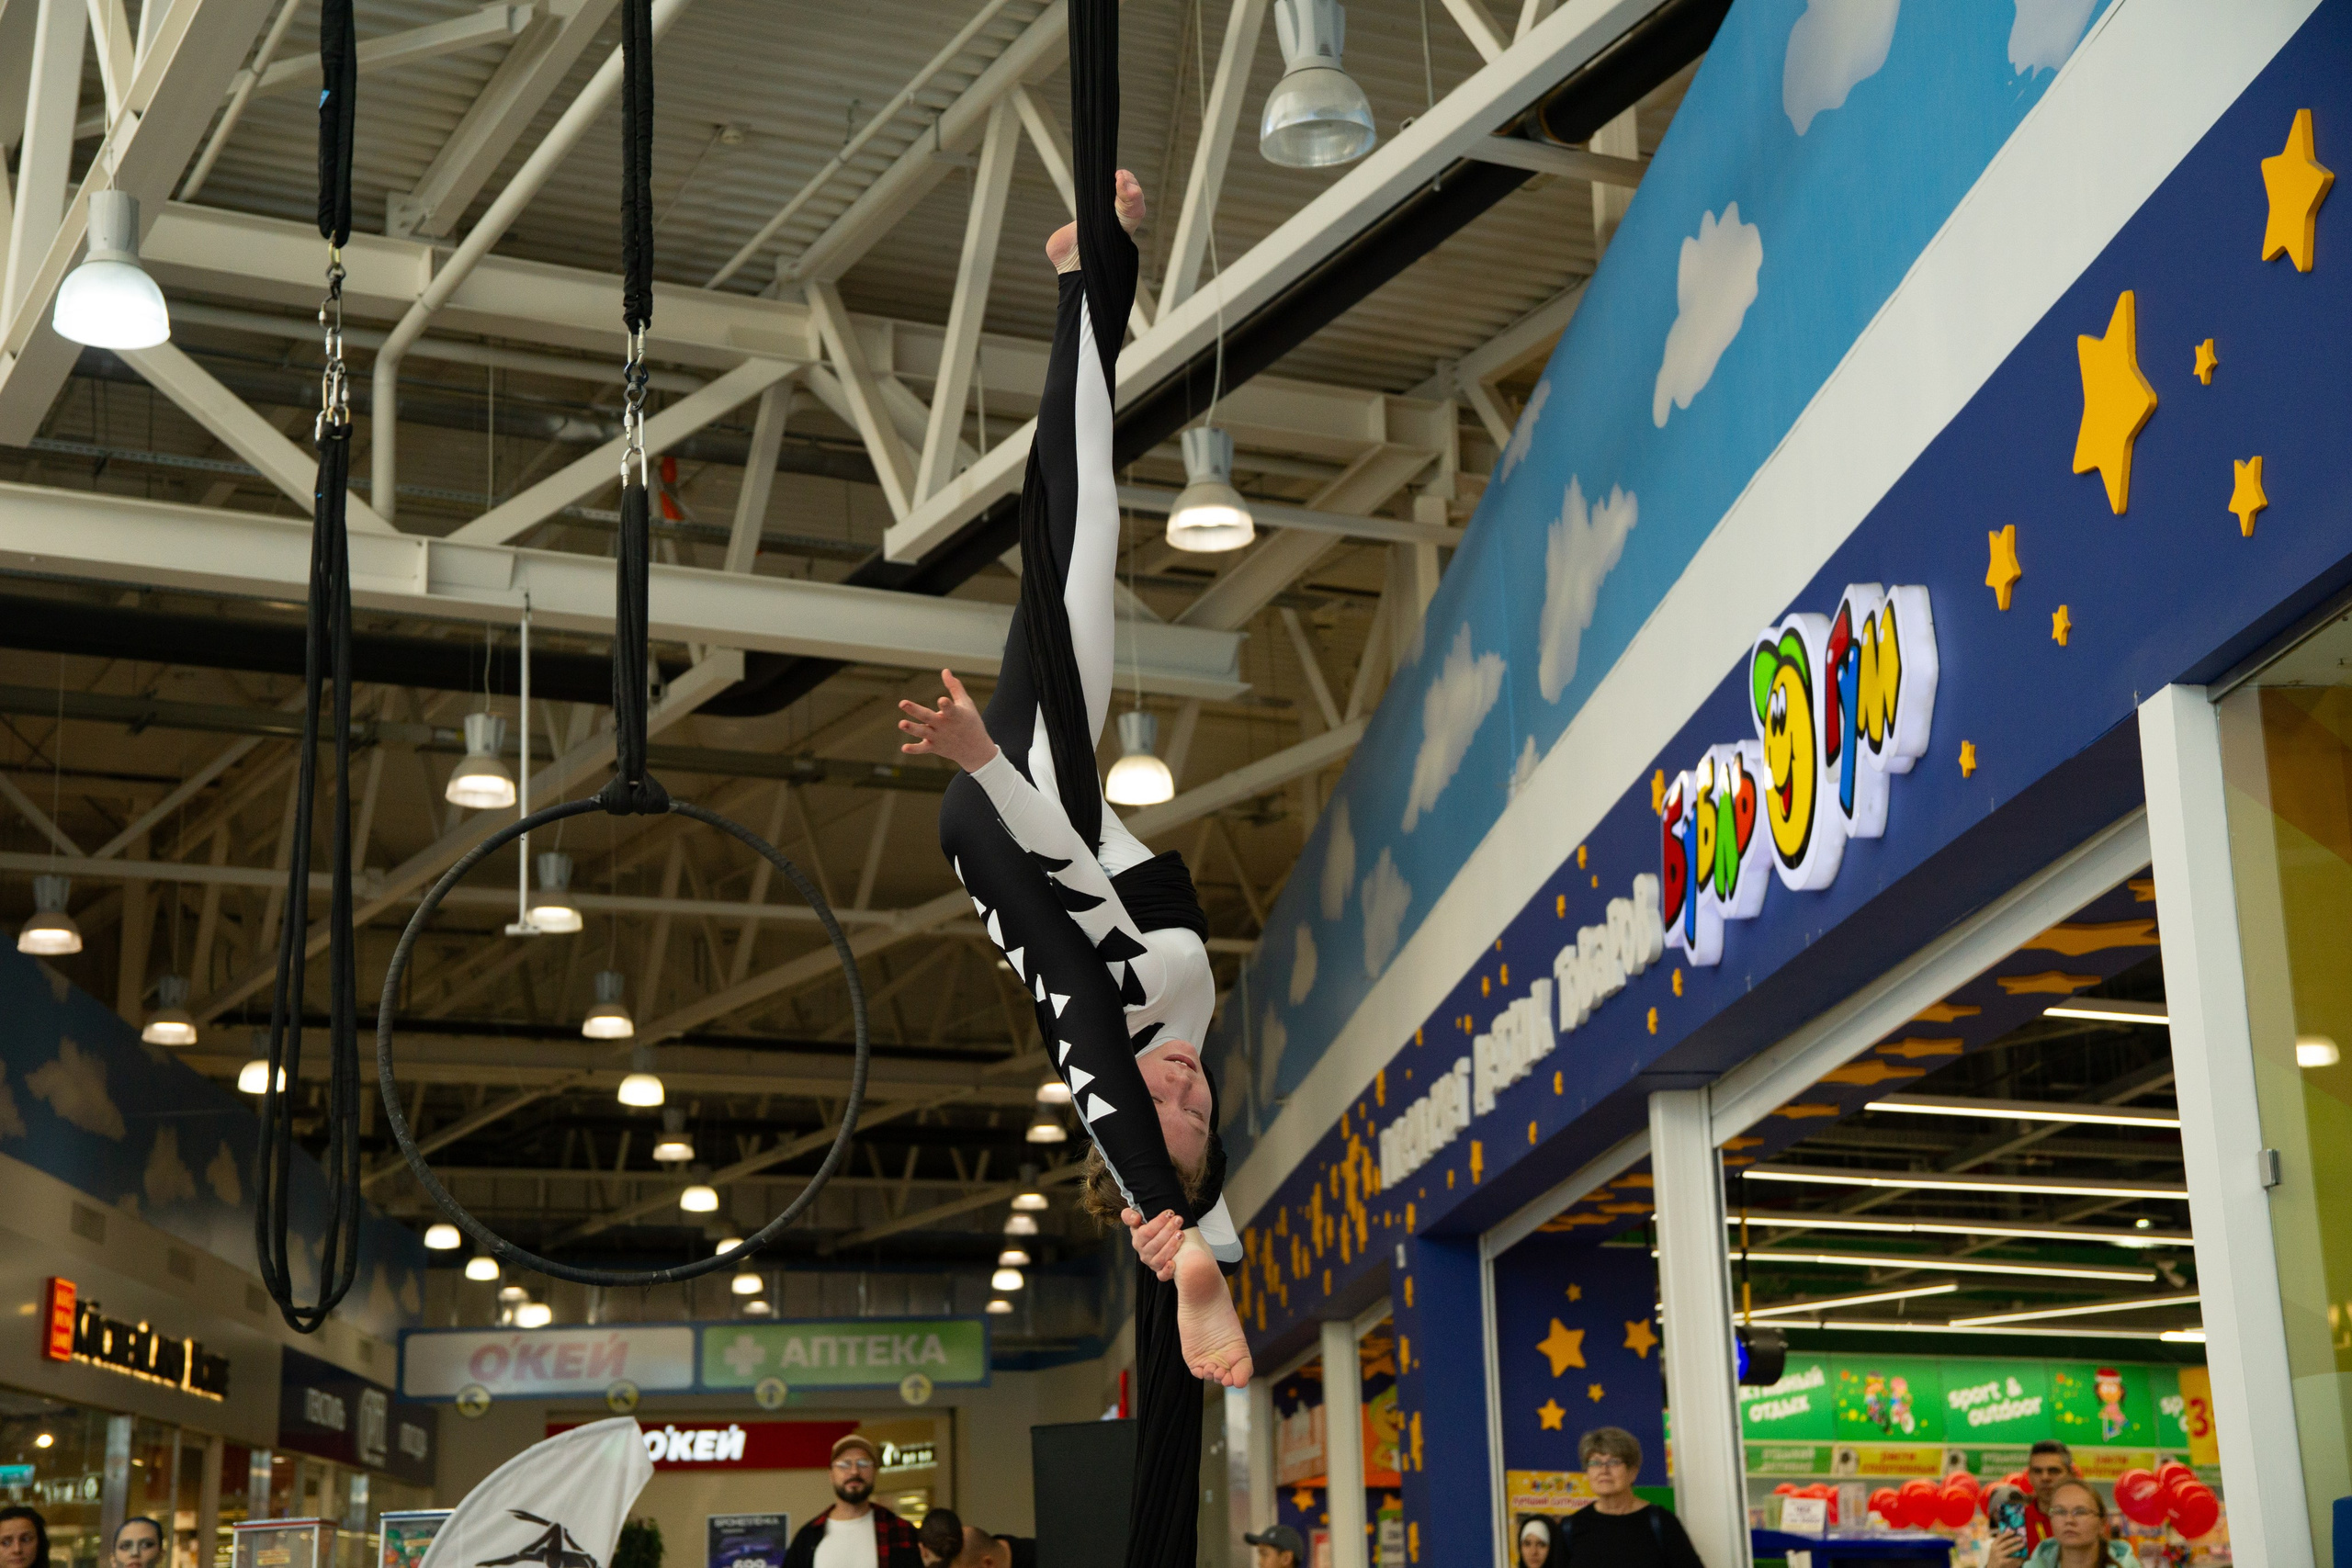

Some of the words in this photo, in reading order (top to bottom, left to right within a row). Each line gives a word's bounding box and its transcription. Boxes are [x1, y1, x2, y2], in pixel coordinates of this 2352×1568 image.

[781, 1334, 947, 1368] АПТЕКА
[1948, 1382, 2001, 1412] sport
[2007, 1377, 2022, 1397] &
[1968, 1396, 2042, 1427] outdoor
